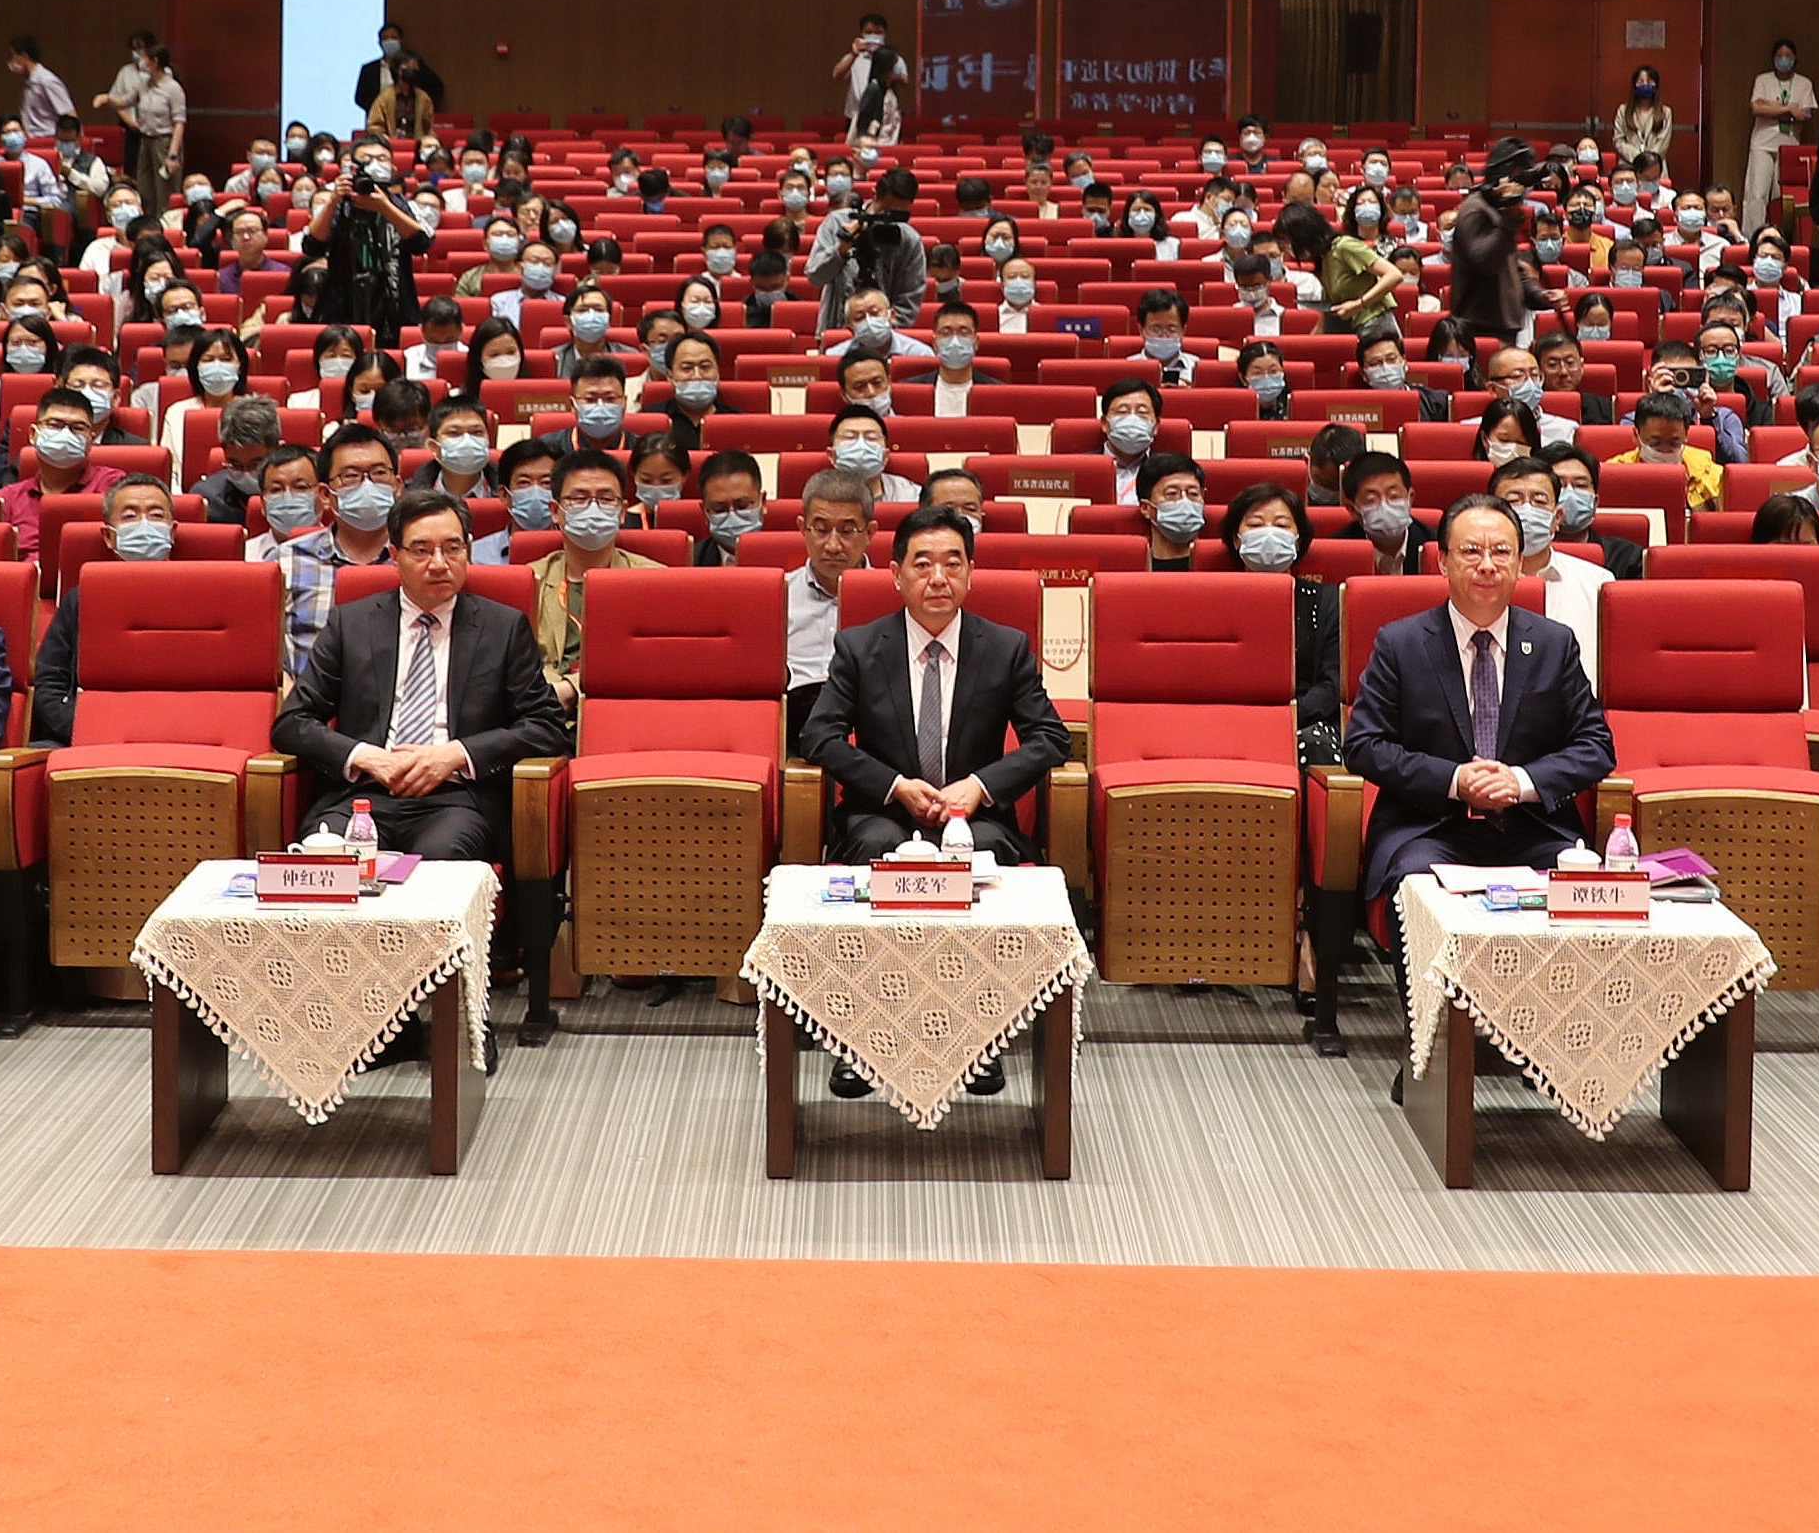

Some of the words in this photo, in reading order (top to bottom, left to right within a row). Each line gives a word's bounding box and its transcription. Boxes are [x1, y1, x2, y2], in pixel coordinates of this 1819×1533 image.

[282, 869, 336, 887] 仲红岩
[895, 876, 948, 894] 张爱军
[1572, 886, 1626, 904] 谭铁牛
